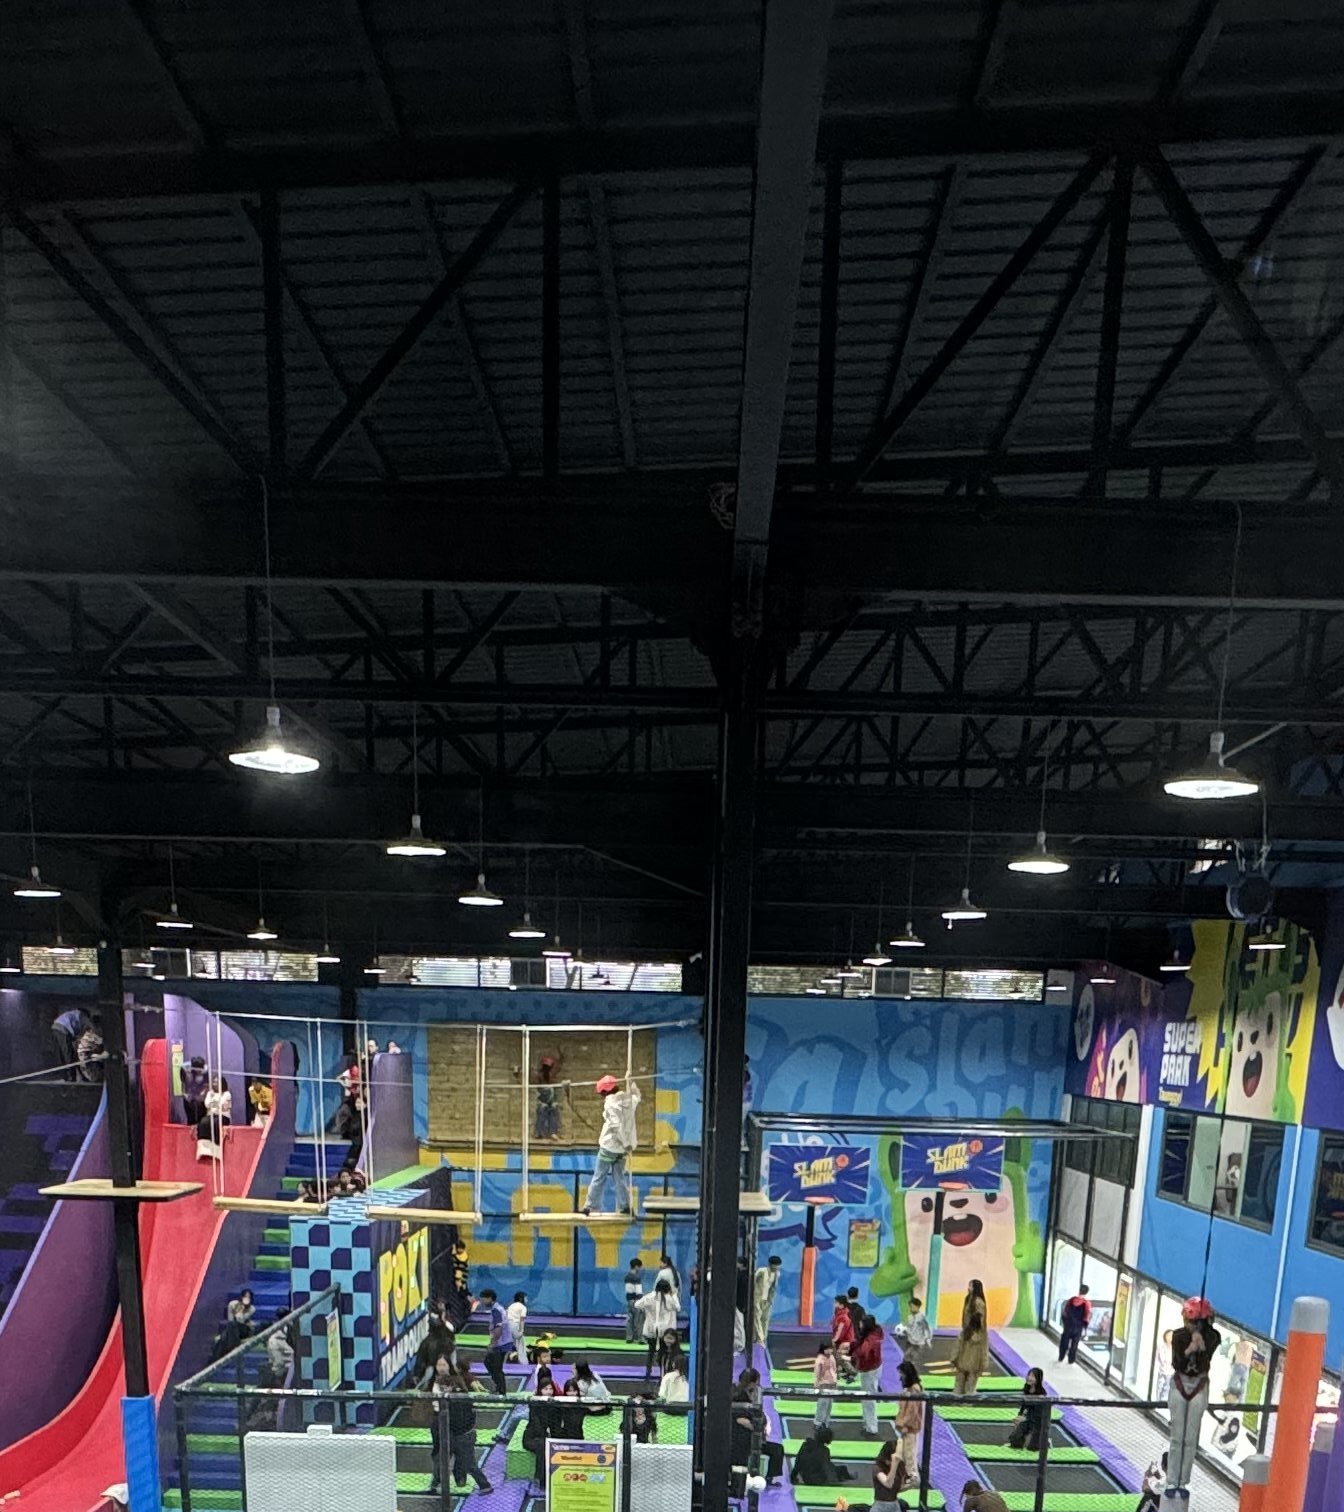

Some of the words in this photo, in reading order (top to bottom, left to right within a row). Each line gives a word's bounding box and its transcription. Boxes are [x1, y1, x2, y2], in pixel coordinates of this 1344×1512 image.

[1163, 1021, 1203, 1054] SUPER
[1159, 1056, 1192, 1086] PARK
[926, 1143, 968, 1164] SLAM
[793, 1156, 834, 1179] SLAM
[934, 1158, 970, 1175] DUNK
[800, 1171, 837, 1190] DUNK
[378, 1226, 429, 1340] POKI
